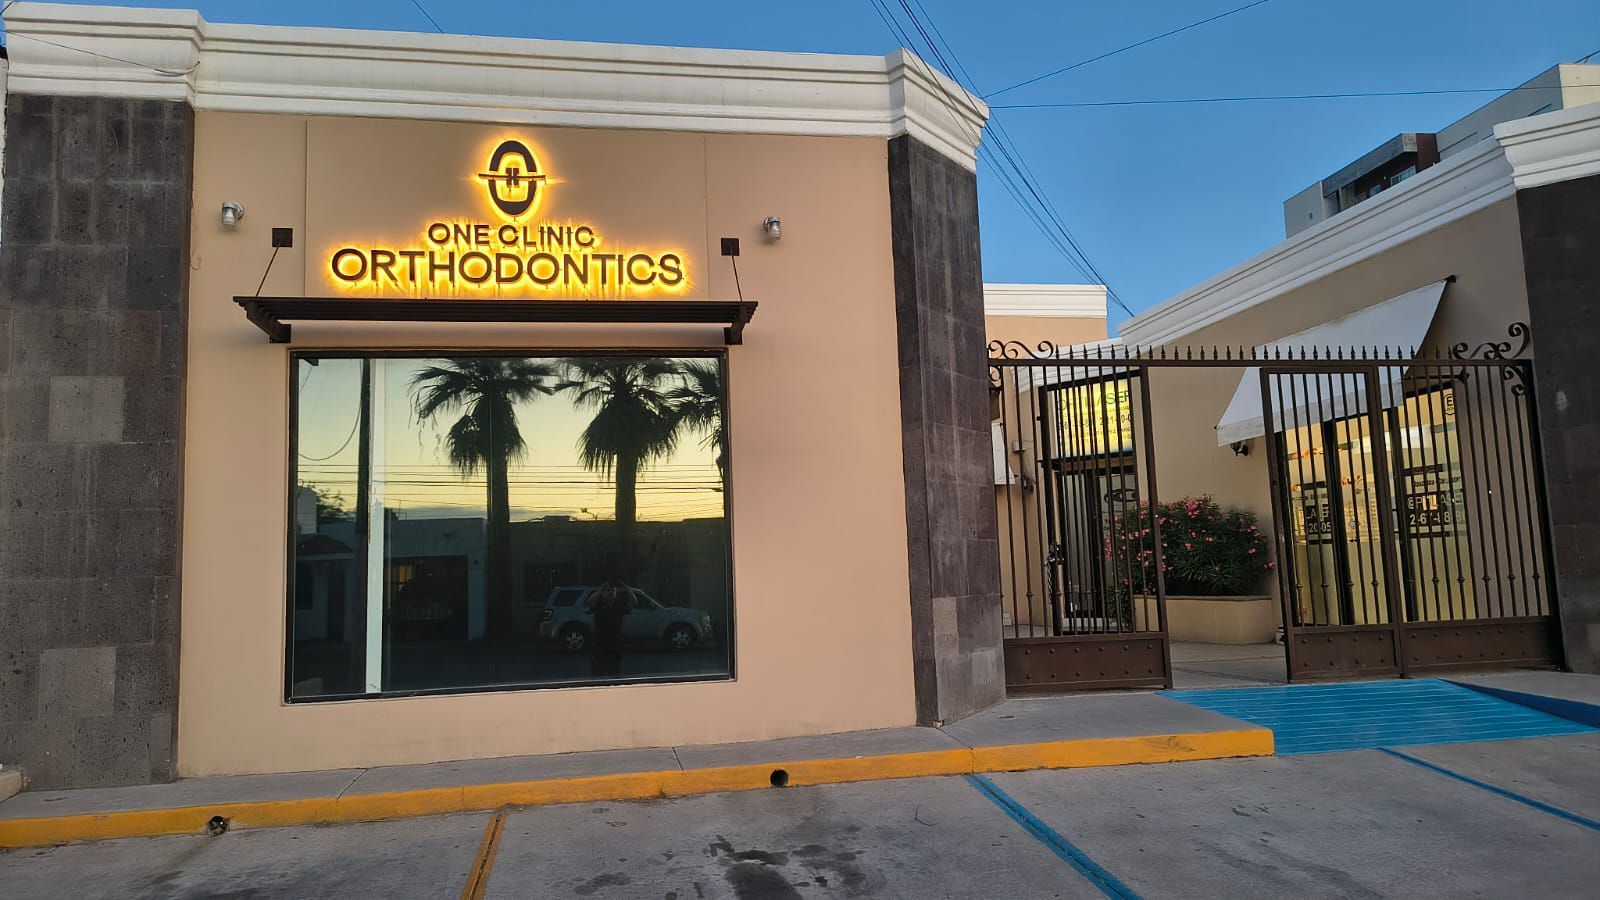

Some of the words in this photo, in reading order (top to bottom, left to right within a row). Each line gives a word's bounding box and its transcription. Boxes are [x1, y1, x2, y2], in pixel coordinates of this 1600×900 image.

[428, 223, 490, 245] ONE
[498, 225, 595, 247] CLINIC
[332, 248, 684, 285] ORTHODONTICS
